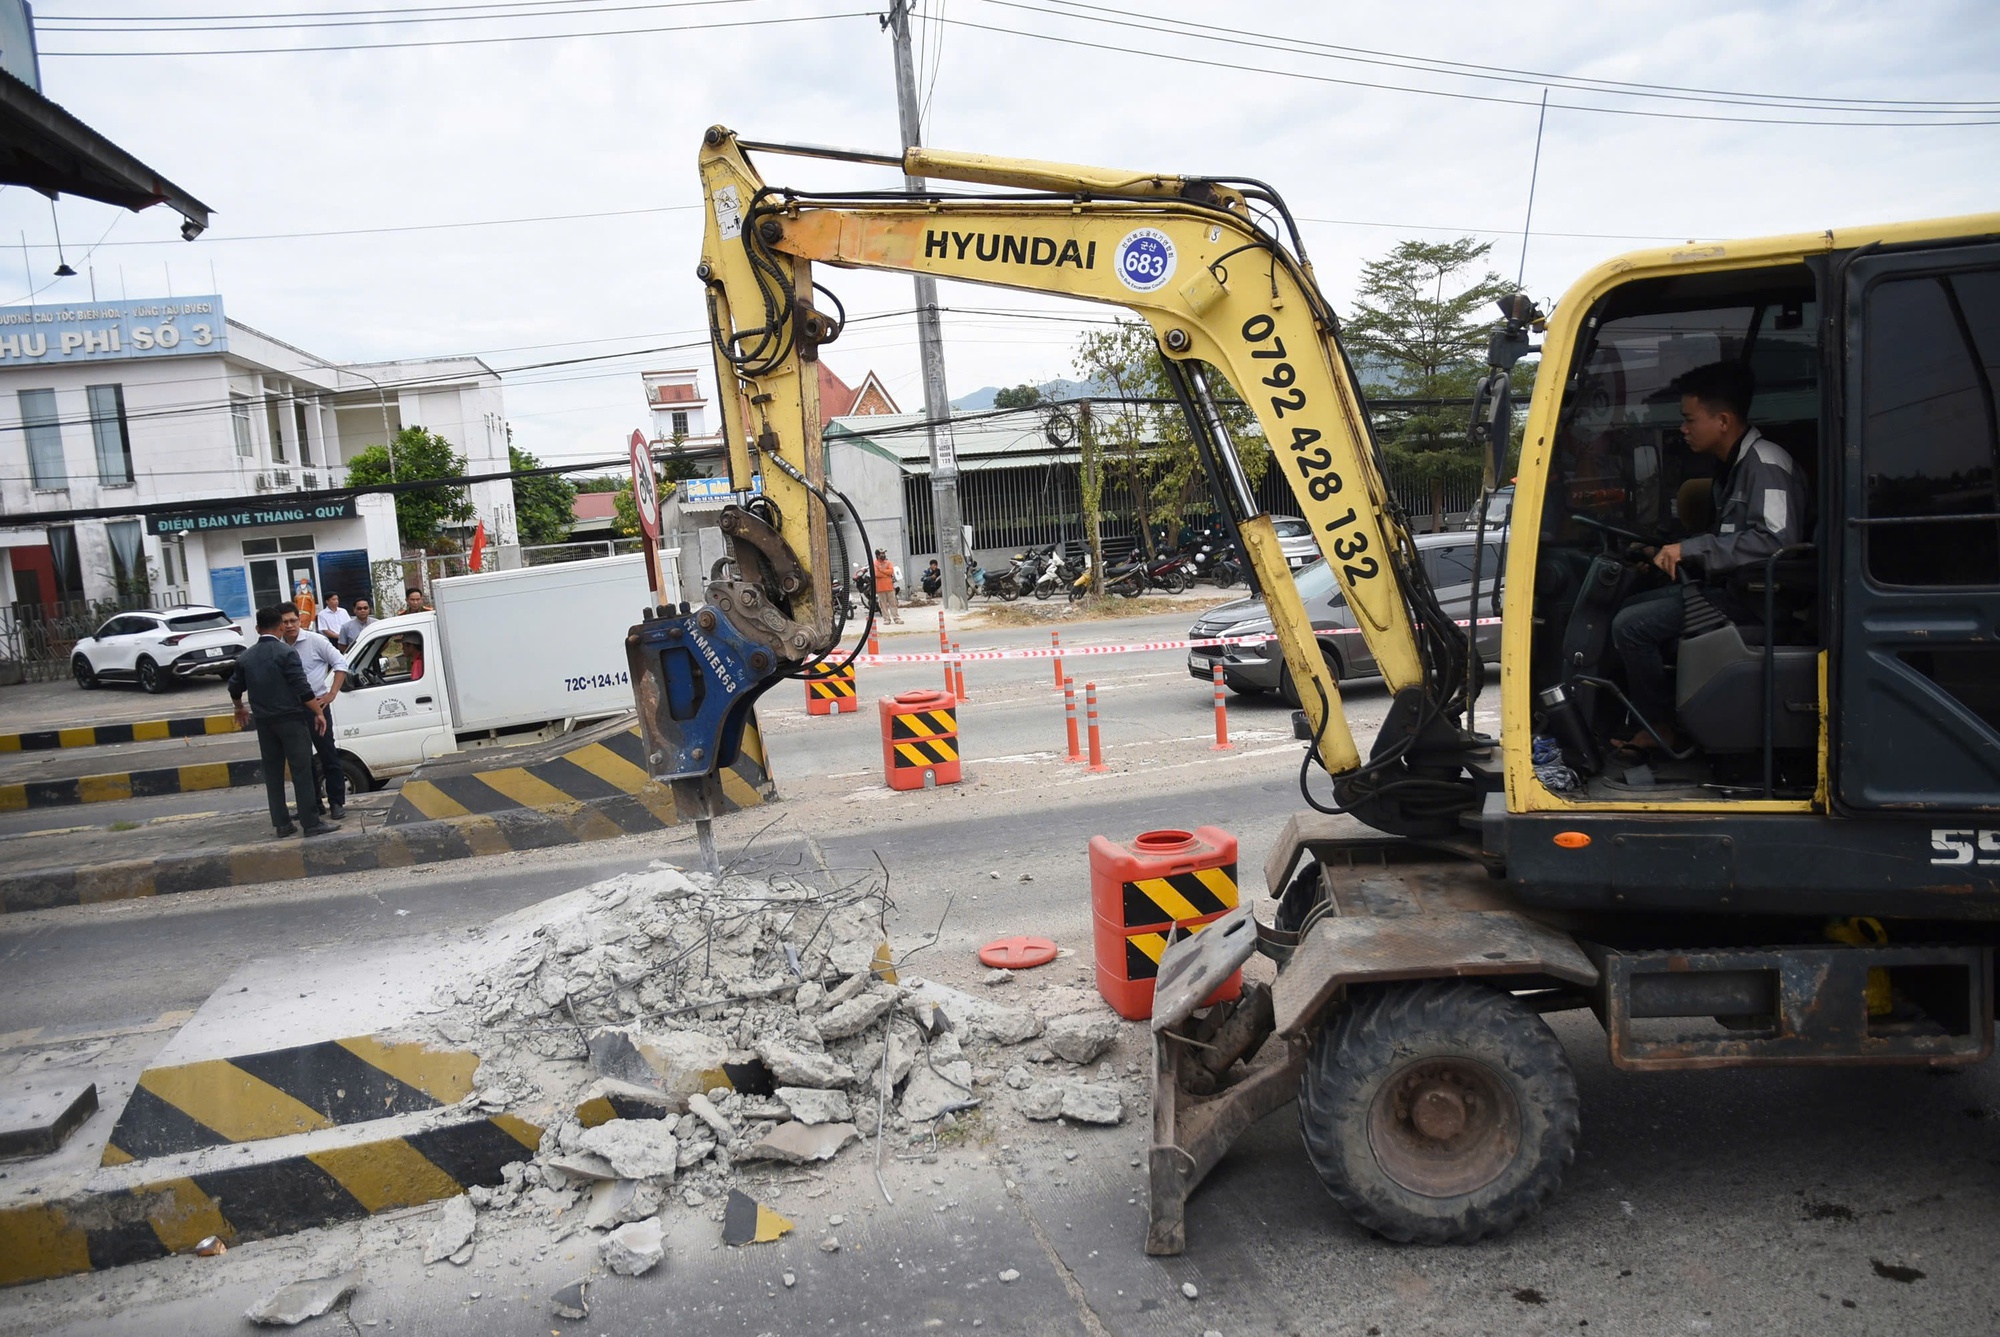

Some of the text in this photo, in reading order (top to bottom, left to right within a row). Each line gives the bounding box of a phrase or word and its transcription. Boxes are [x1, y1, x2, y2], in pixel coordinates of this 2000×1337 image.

[925, 230, 1096, 269] HYUNDAI
[1126, 251, 1164, 276] 683
[60, 324, 121, 355] PHÍ
[132, 316, 180, 350] SỐ
[192, 323, 213, 346] 3
[1242, 314, 1379, 587] 0792 428 132
[684, 618, 737, 693] HAMMER68
[564, 671, 629, 692] 72C-124.14
